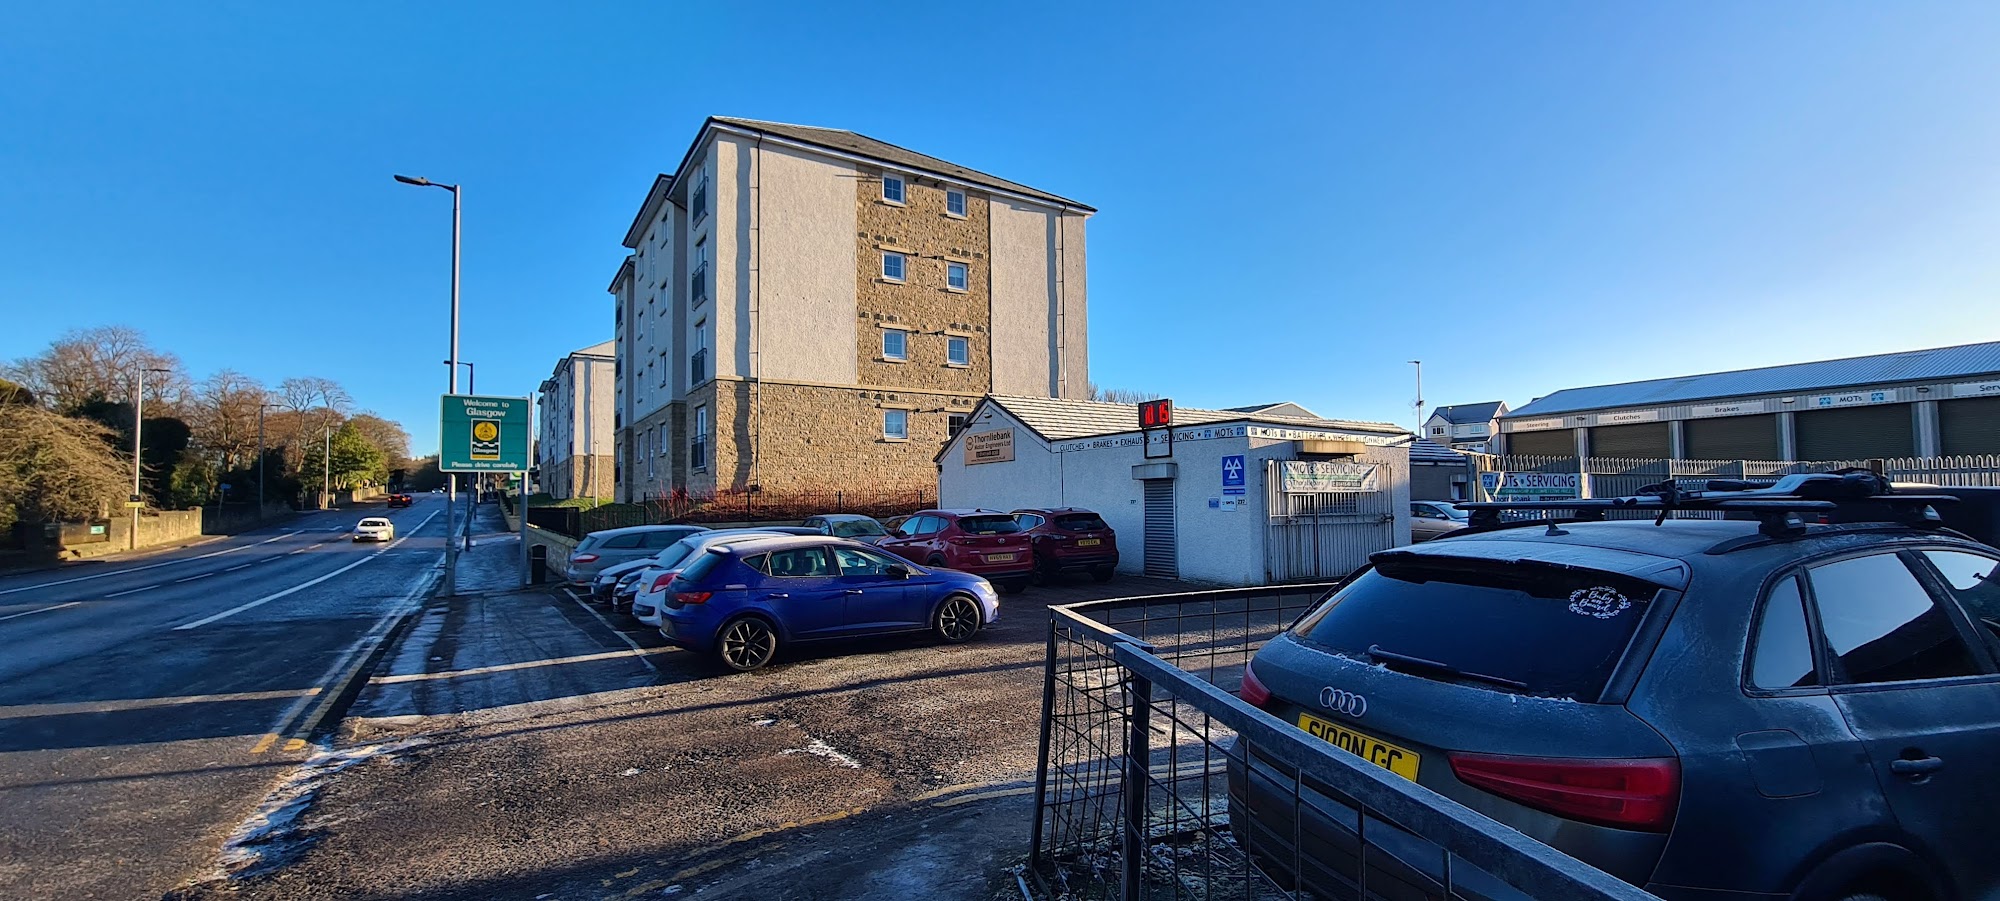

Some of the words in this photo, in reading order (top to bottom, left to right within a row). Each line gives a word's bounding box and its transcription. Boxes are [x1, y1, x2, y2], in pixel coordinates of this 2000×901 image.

[463, 399, 498, 407] Welcome
[466, 407, 506, 418] Glasgow
[974, 431, 1011, 443] Thornliebank
[1261, 428, 1277, 437] MOTs
[985, 441, 1003, 449] Engineers
[1060, 442, 1085, 451] CLUTCHES
[1093, 439, 1113, 448] BRAKES
[1120, 436, 1150, 446] EXHAUSS
[1214, 428, 1234, 437] MOTs
[1321, 464, 1361, 475] SERVICING
[1526, 475, 1575, 487] SERVICING
[1588, 591, 1615, 604] Baby
[1579, 598, 1611, 612] Board
